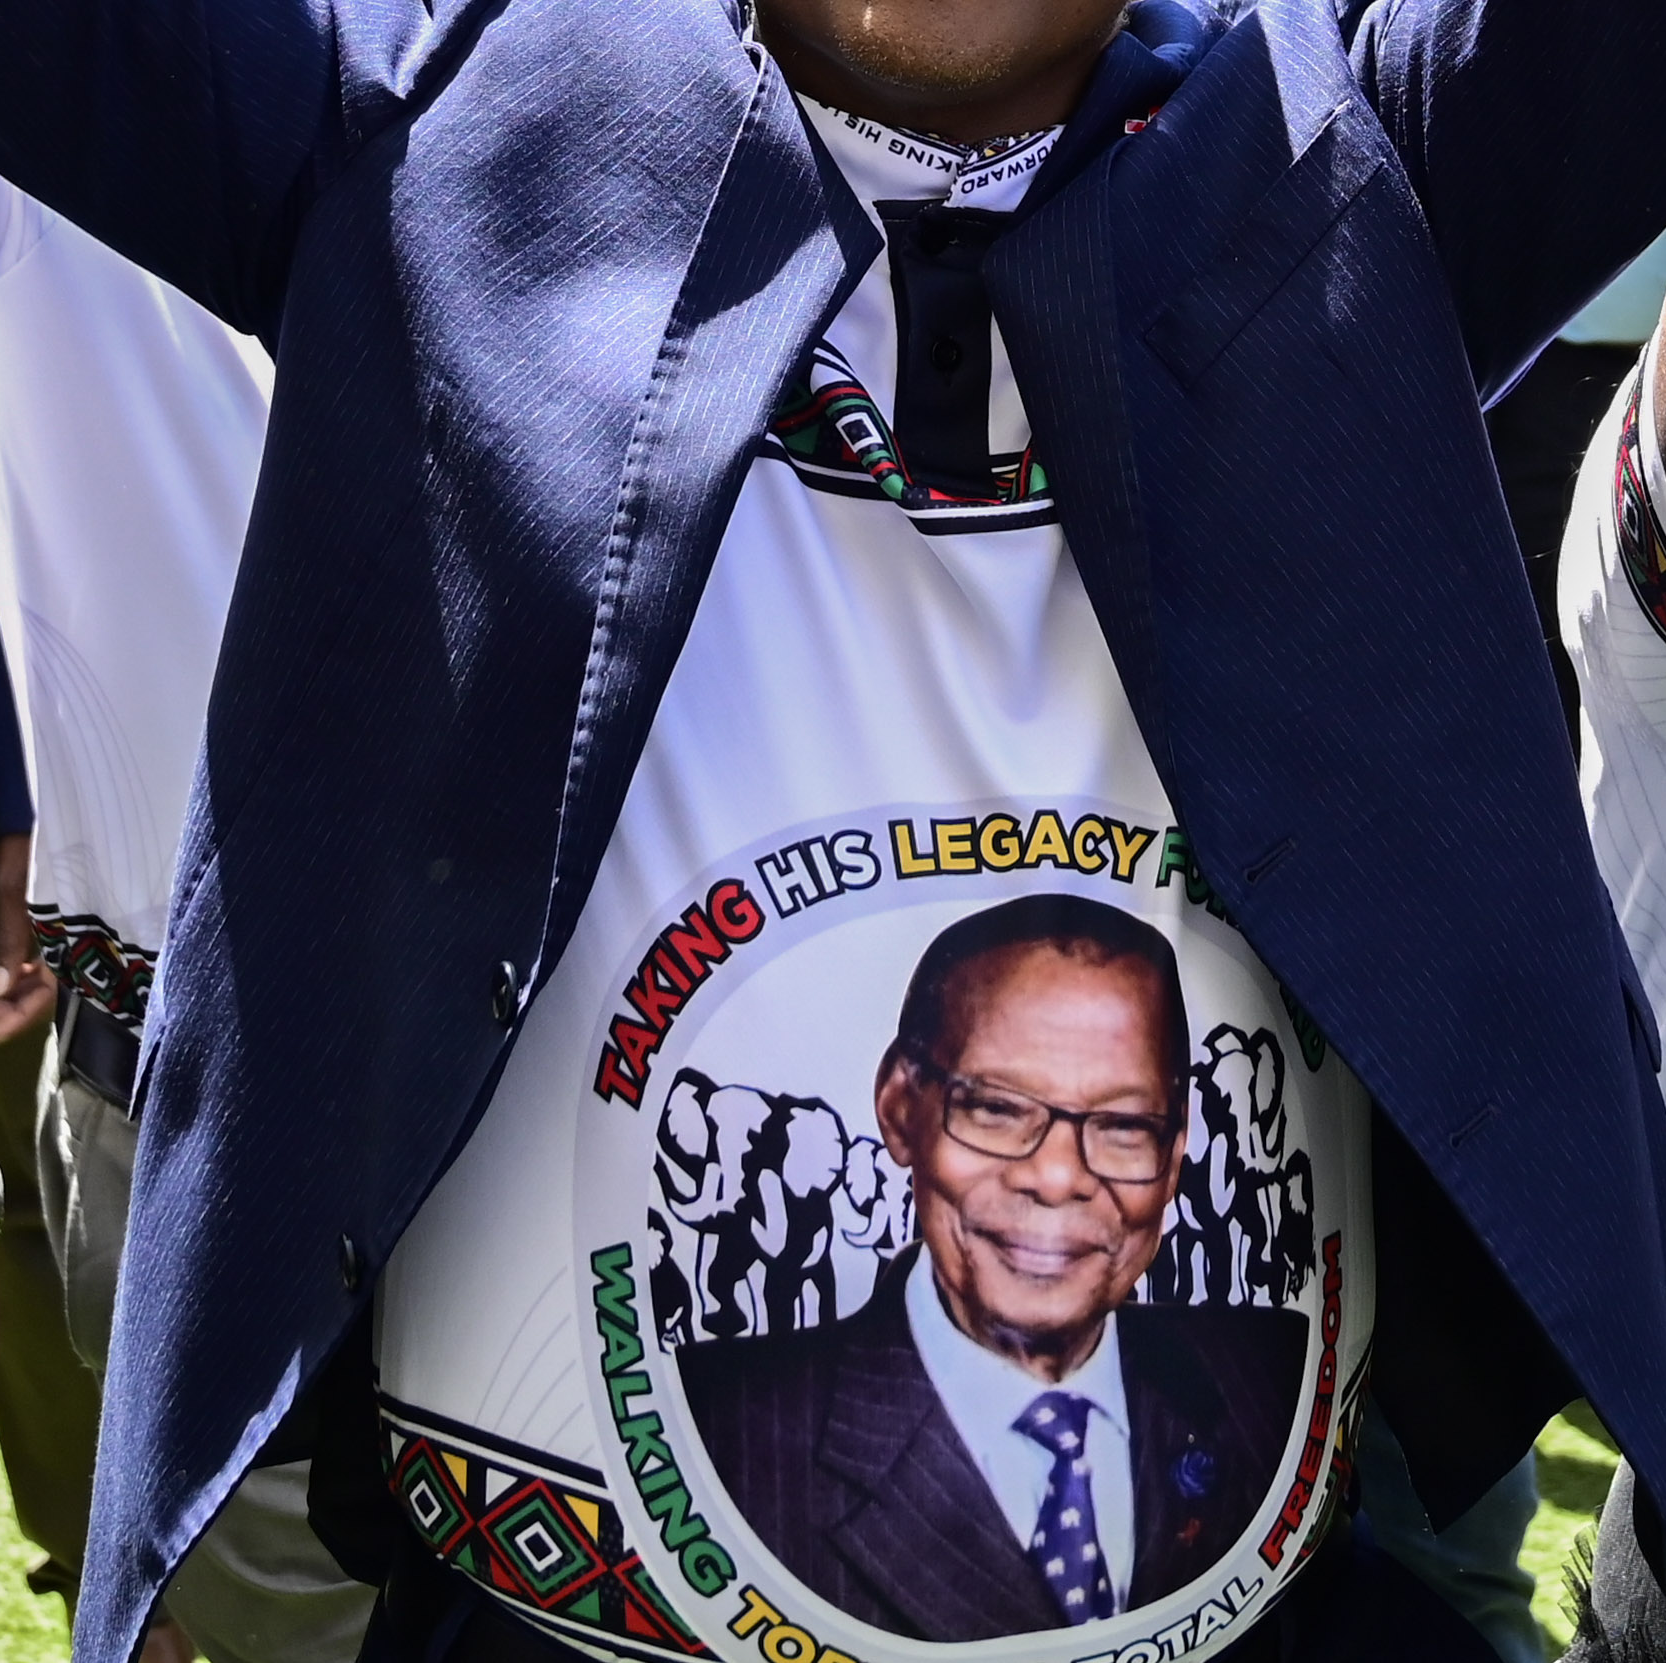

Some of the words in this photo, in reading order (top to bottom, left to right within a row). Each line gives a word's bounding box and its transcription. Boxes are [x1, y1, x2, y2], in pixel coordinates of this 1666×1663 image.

[844, 116, 883, 143] HIS
[961, 136, 1058, 194] ORWARD
[593, 877, 766, 1112] TAKING
[754, 829, 882, 920] HIS
[887, 808, 1159, 884] LEGACY
[590, 1241, 738, 1598] WALKING
[1258, 1230, 1344, 1571] FREEDOM
